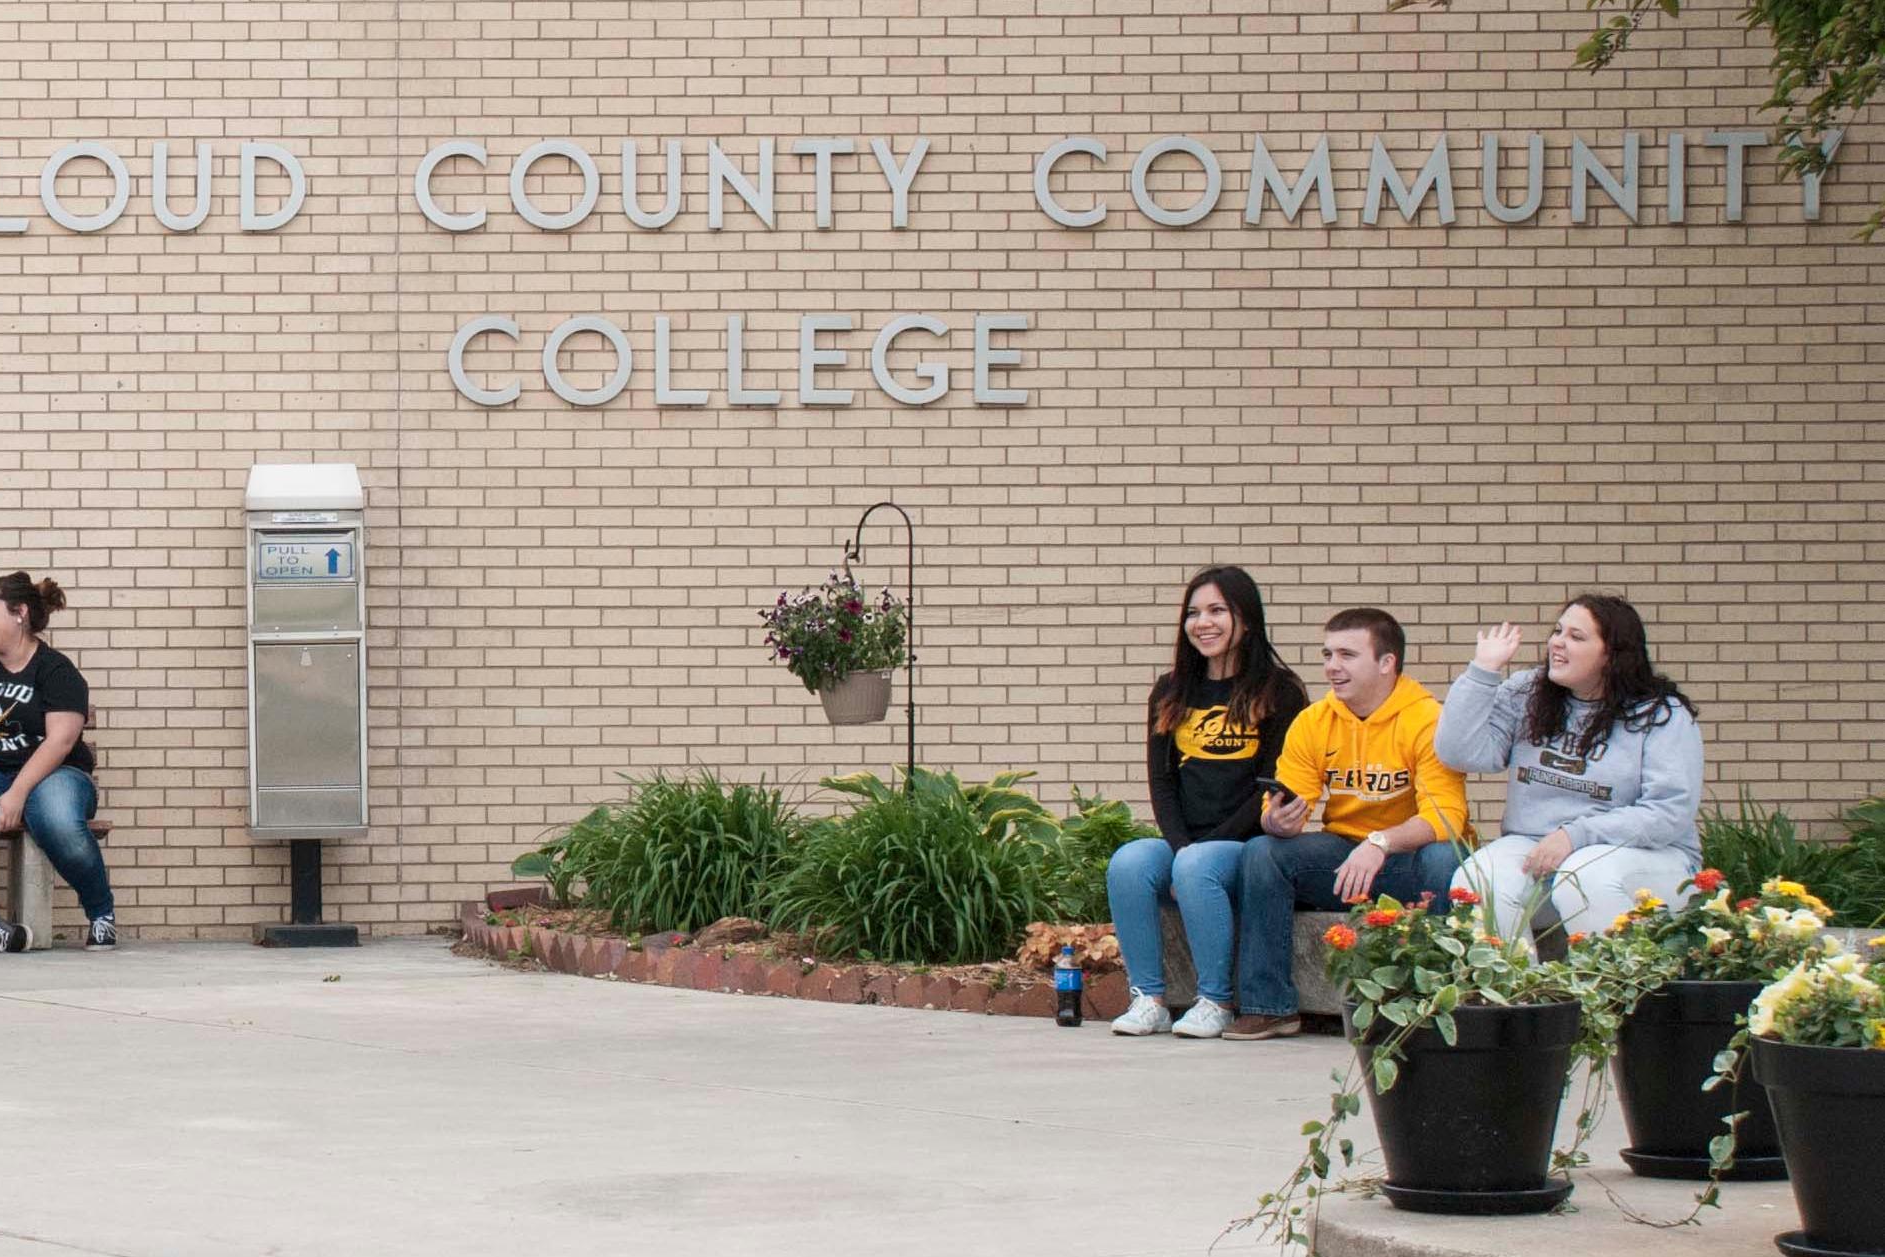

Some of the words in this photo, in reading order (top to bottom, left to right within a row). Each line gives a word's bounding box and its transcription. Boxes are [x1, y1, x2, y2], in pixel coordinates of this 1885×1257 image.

[414, 138, 931, 232] COUNTY
[1032, 131, 1845, 228] COMMUNITY
[448, 315, 1030, 406] COLLEGE
[267, 546, 309, 555] PULL
[278, 556, 299, 565] TO
[266, 566, 313, 575] OPEN
